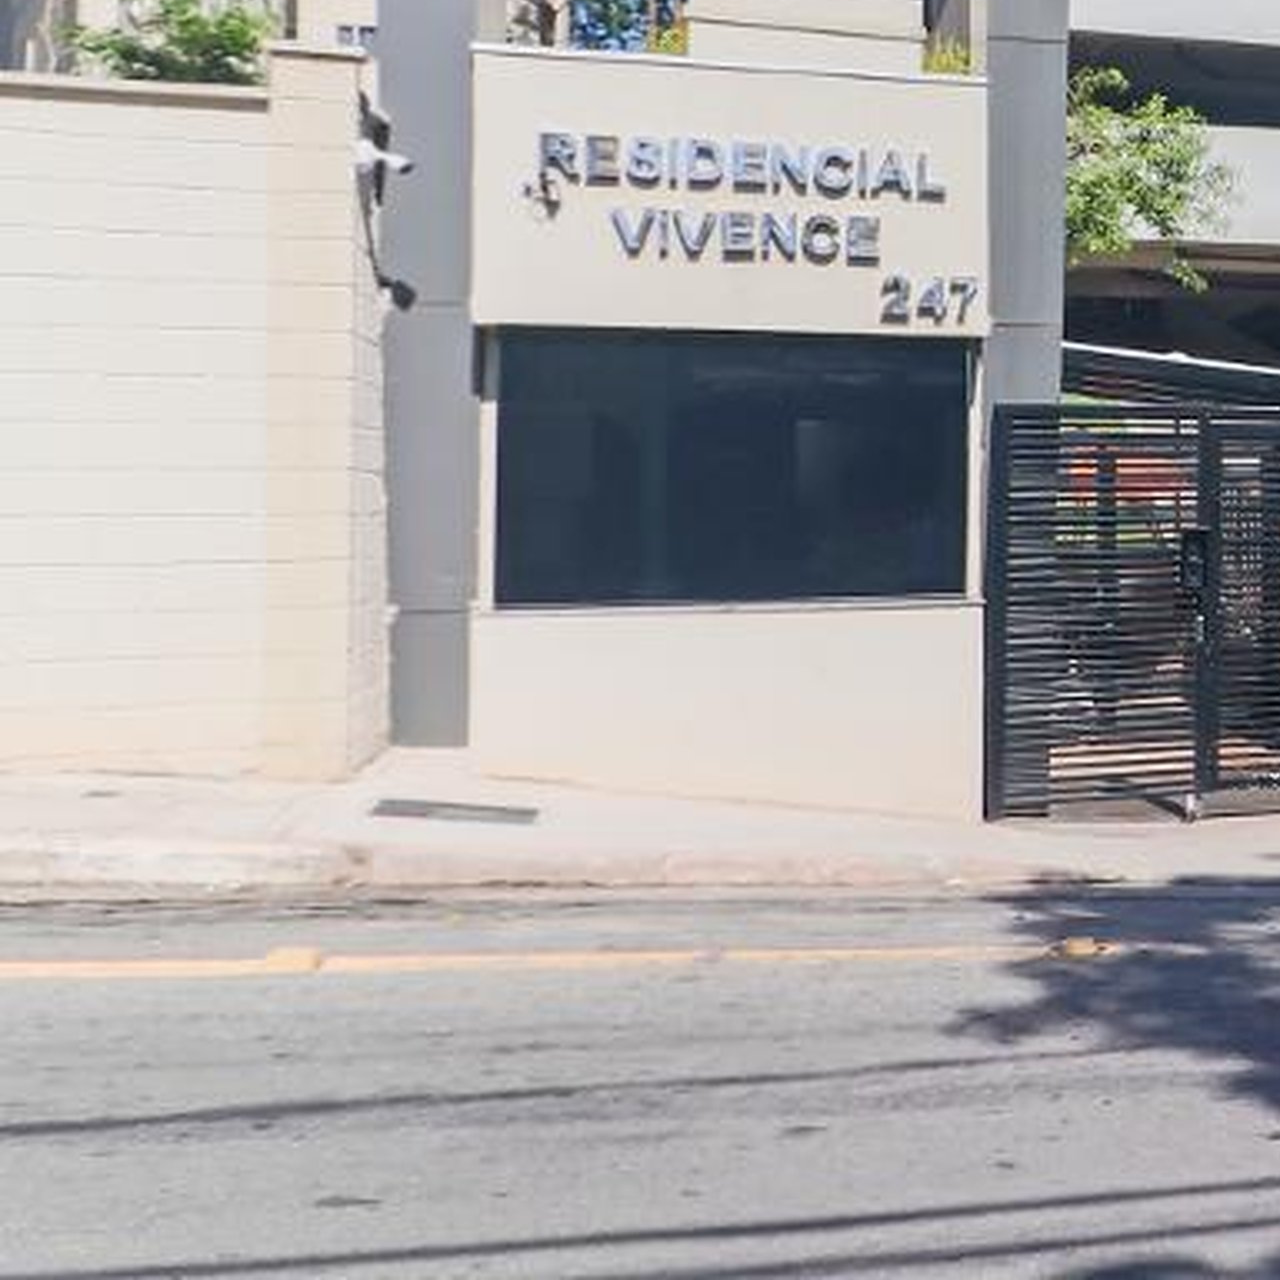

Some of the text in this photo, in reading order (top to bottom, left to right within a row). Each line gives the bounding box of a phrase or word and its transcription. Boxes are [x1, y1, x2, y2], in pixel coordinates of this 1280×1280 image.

[538, 132, 947, 204] RESIDENCIAL
[612, 208, 881, 267] VIVENCE
[880, 273, 978, 326] 247
